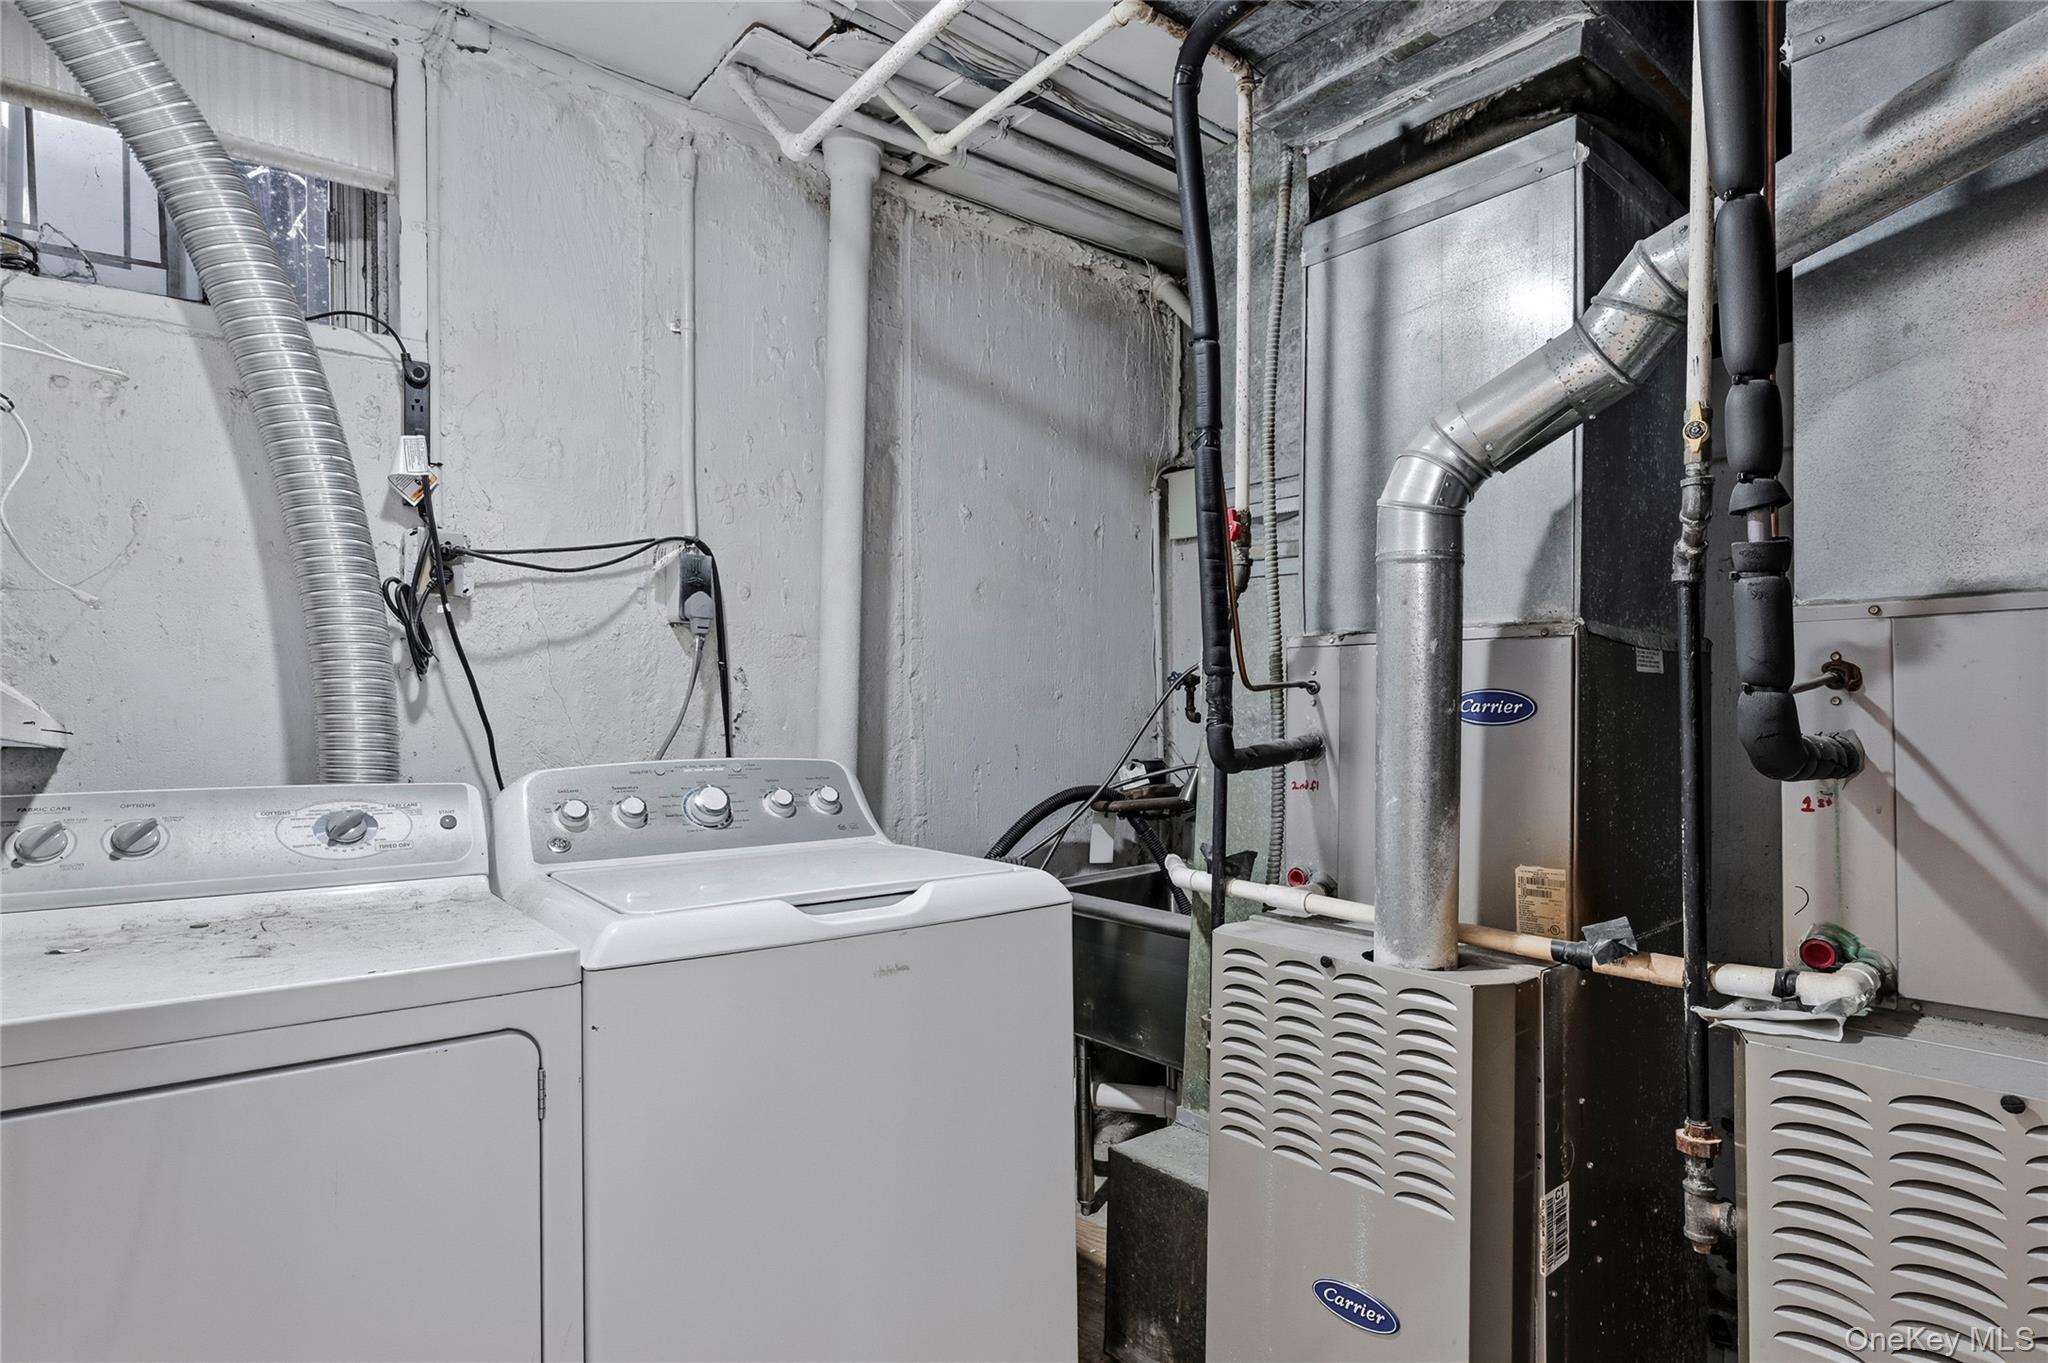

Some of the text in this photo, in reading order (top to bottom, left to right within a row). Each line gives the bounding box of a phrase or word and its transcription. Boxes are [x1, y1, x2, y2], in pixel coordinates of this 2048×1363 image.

[1461, 699, 1523, 714] Carrier
[1555, 1186, 1565, 1201] C1
[1323, 1288, 1386, 1324] Carrier
